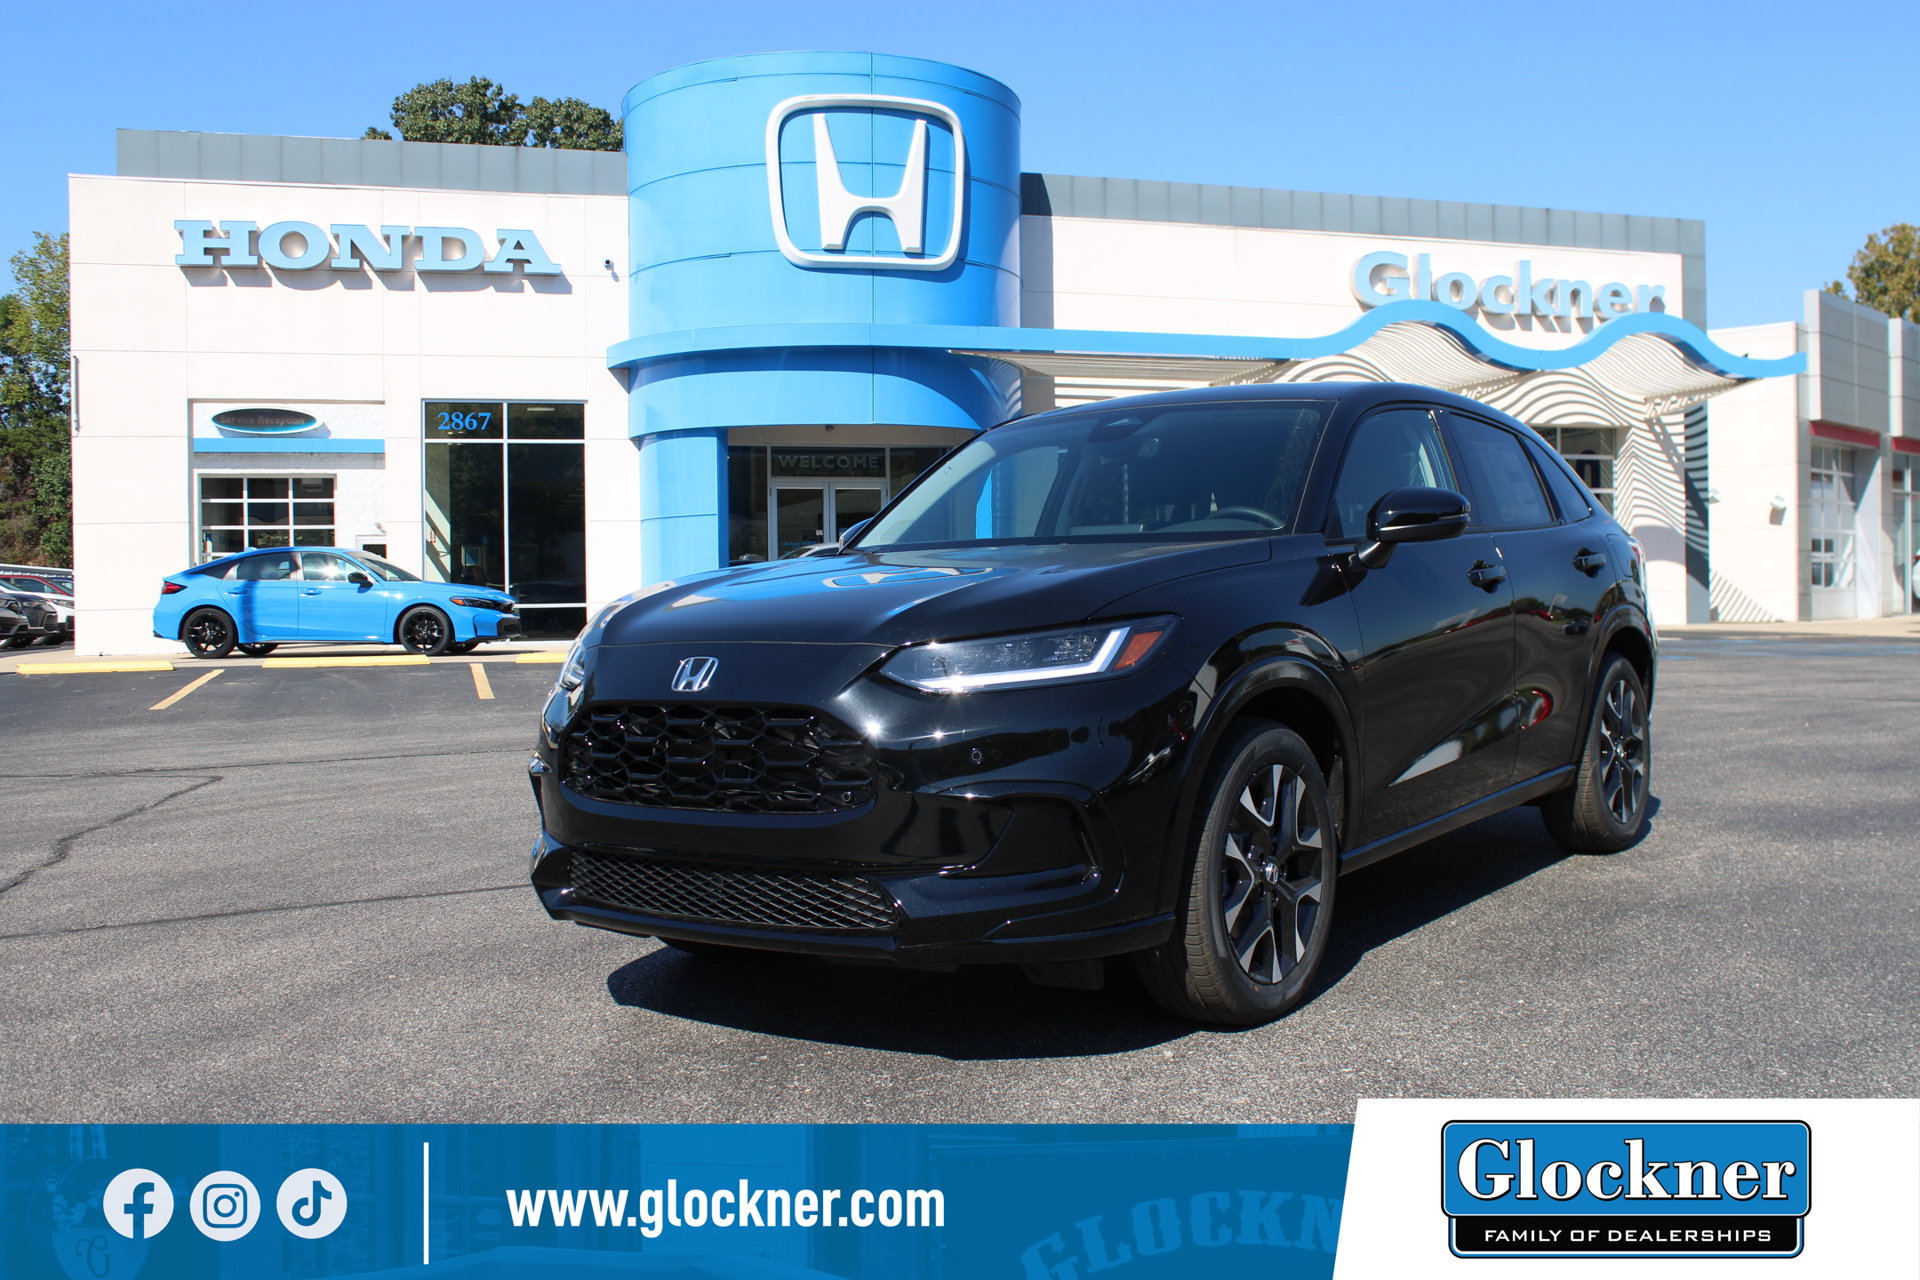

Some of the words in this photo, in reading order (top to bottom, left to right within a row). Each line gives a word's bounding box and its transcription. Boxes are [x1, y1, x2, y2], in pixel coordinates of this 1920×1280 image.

[174, 219, 562, 276] HONDA
[1352, 250, 1666, 318] Glockner
[437, 411, 492, 430] 2867
[778, 455, 879, 469] WELCOME
